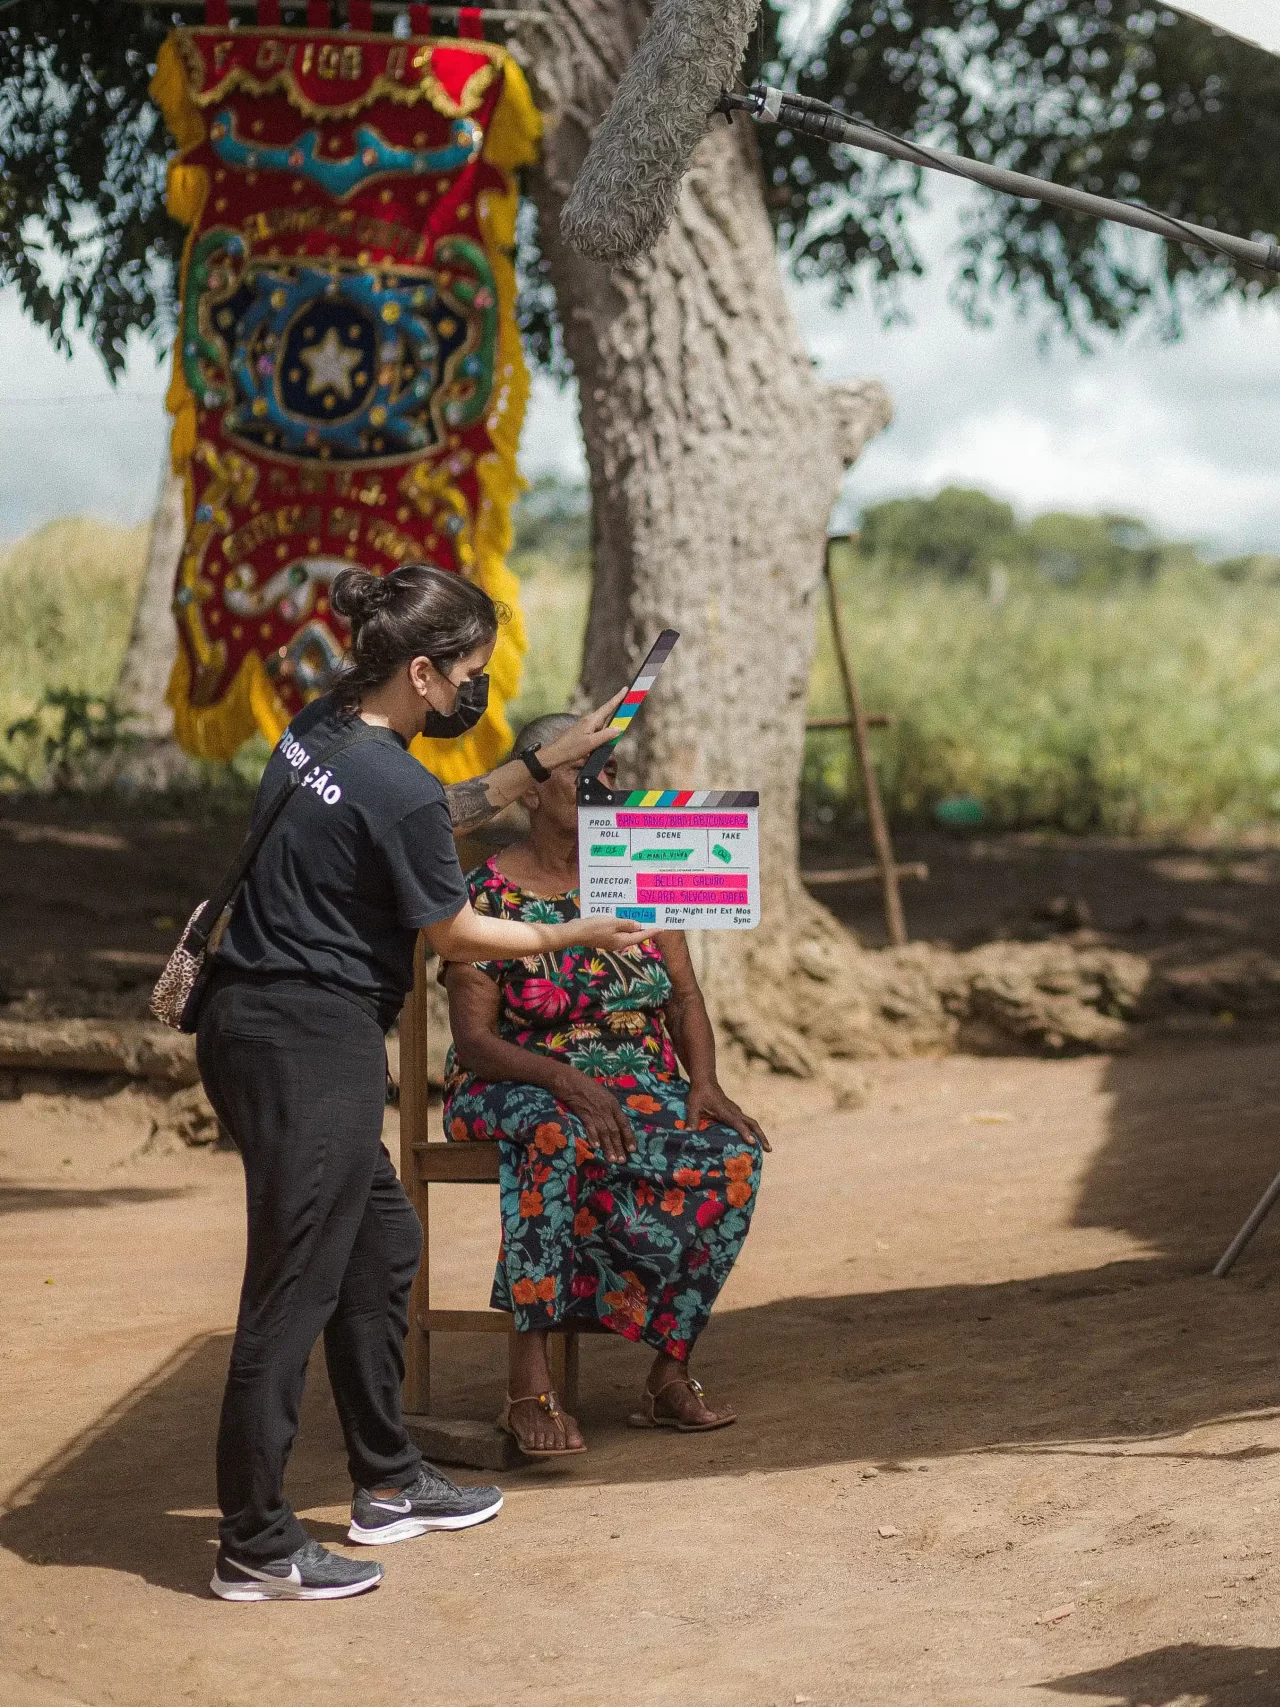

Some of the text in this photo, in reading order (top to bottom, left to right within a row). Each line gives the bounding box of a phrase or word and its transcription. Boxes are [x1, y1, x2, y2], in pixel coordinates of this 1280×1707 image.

[589, 819, 612, 827] PROD.
[722, 832, 741, 840] TAKE
[590, 877, 632, 885] DIRECTOR:
[654, 873, 725, 888] BELLA GALVÃO
[590, 891, 626, 899] CAMERA:
[590, 906, 613, 914] DATE:
[665, 916, 751, 925] Filter Sync
